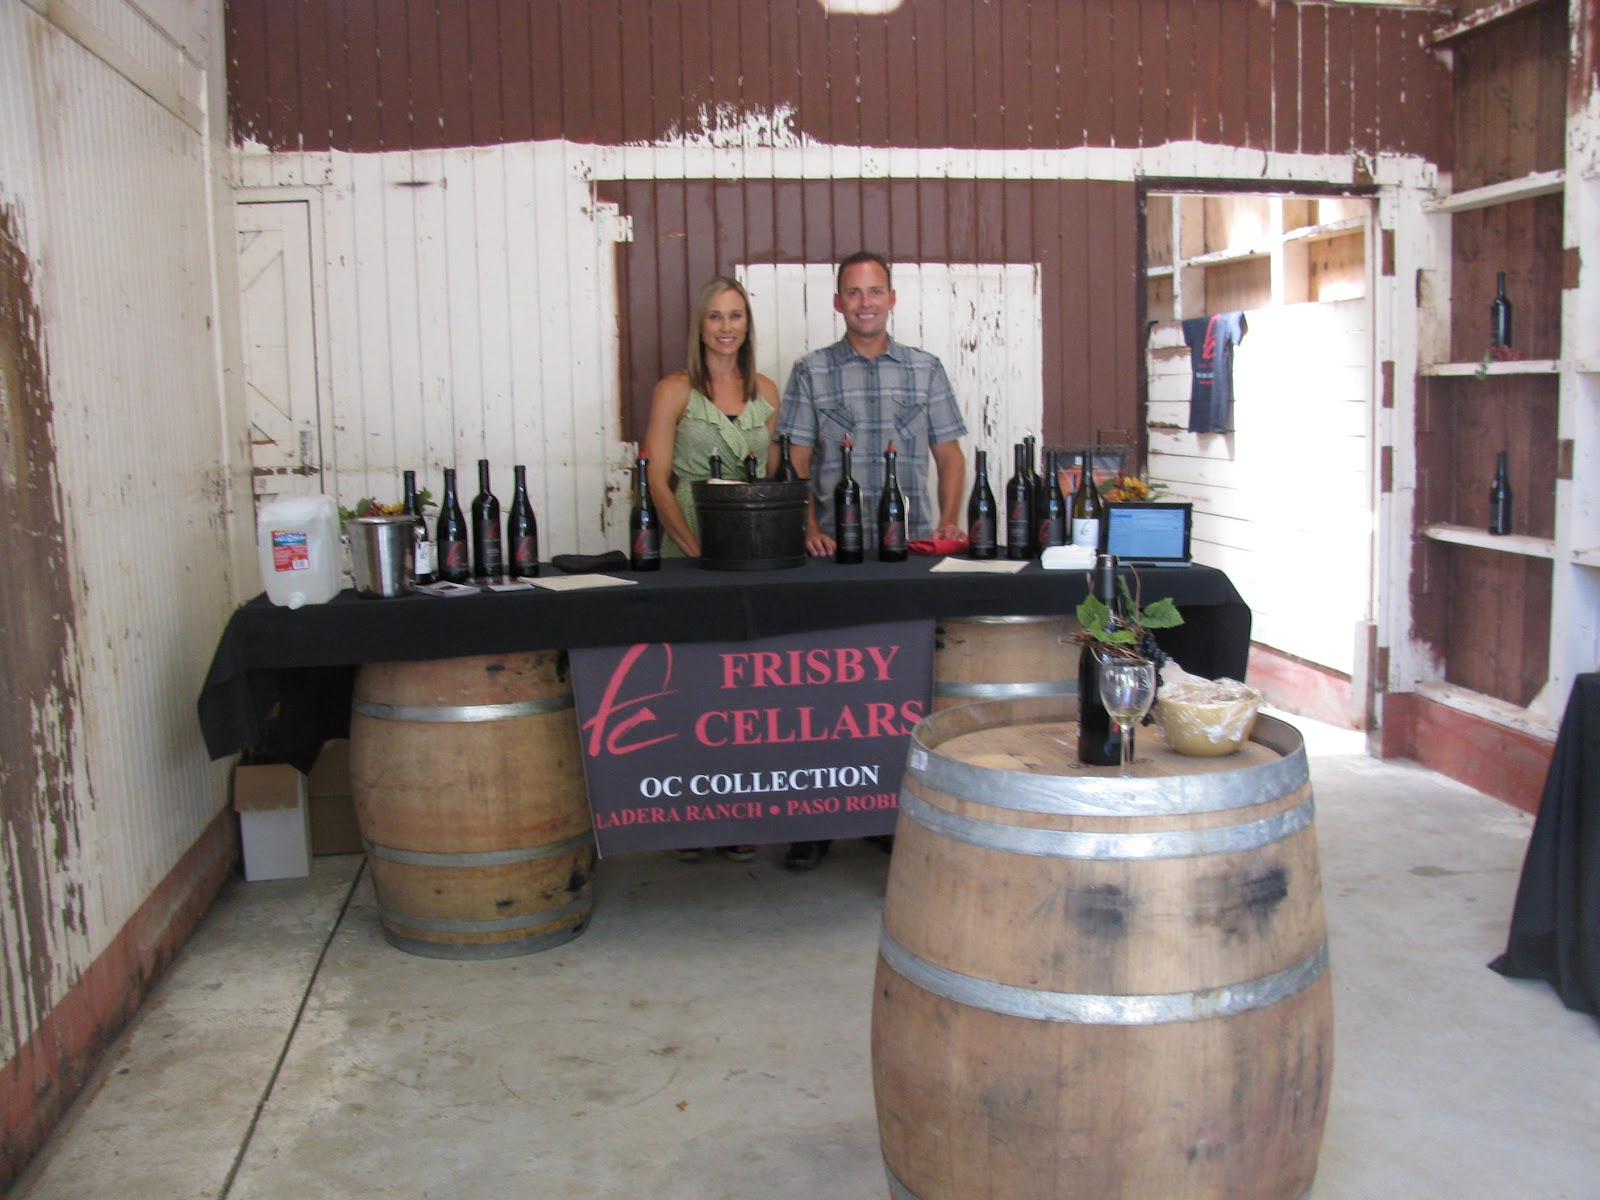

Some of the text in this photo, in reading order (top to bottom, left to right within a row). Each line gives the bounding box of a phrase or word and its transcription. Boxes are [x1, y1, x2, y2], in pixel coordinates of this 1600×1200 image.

[720, 645, 900, 689] FRISBY
[694, 700, 925, 747] CELLARS
[639, 765, 880, 799] OC COLLECTION
[595, 806, 681, 829] LADERA
[685, 801, 763, 821] RANCH
[786, 797, 841, 816] PASO
